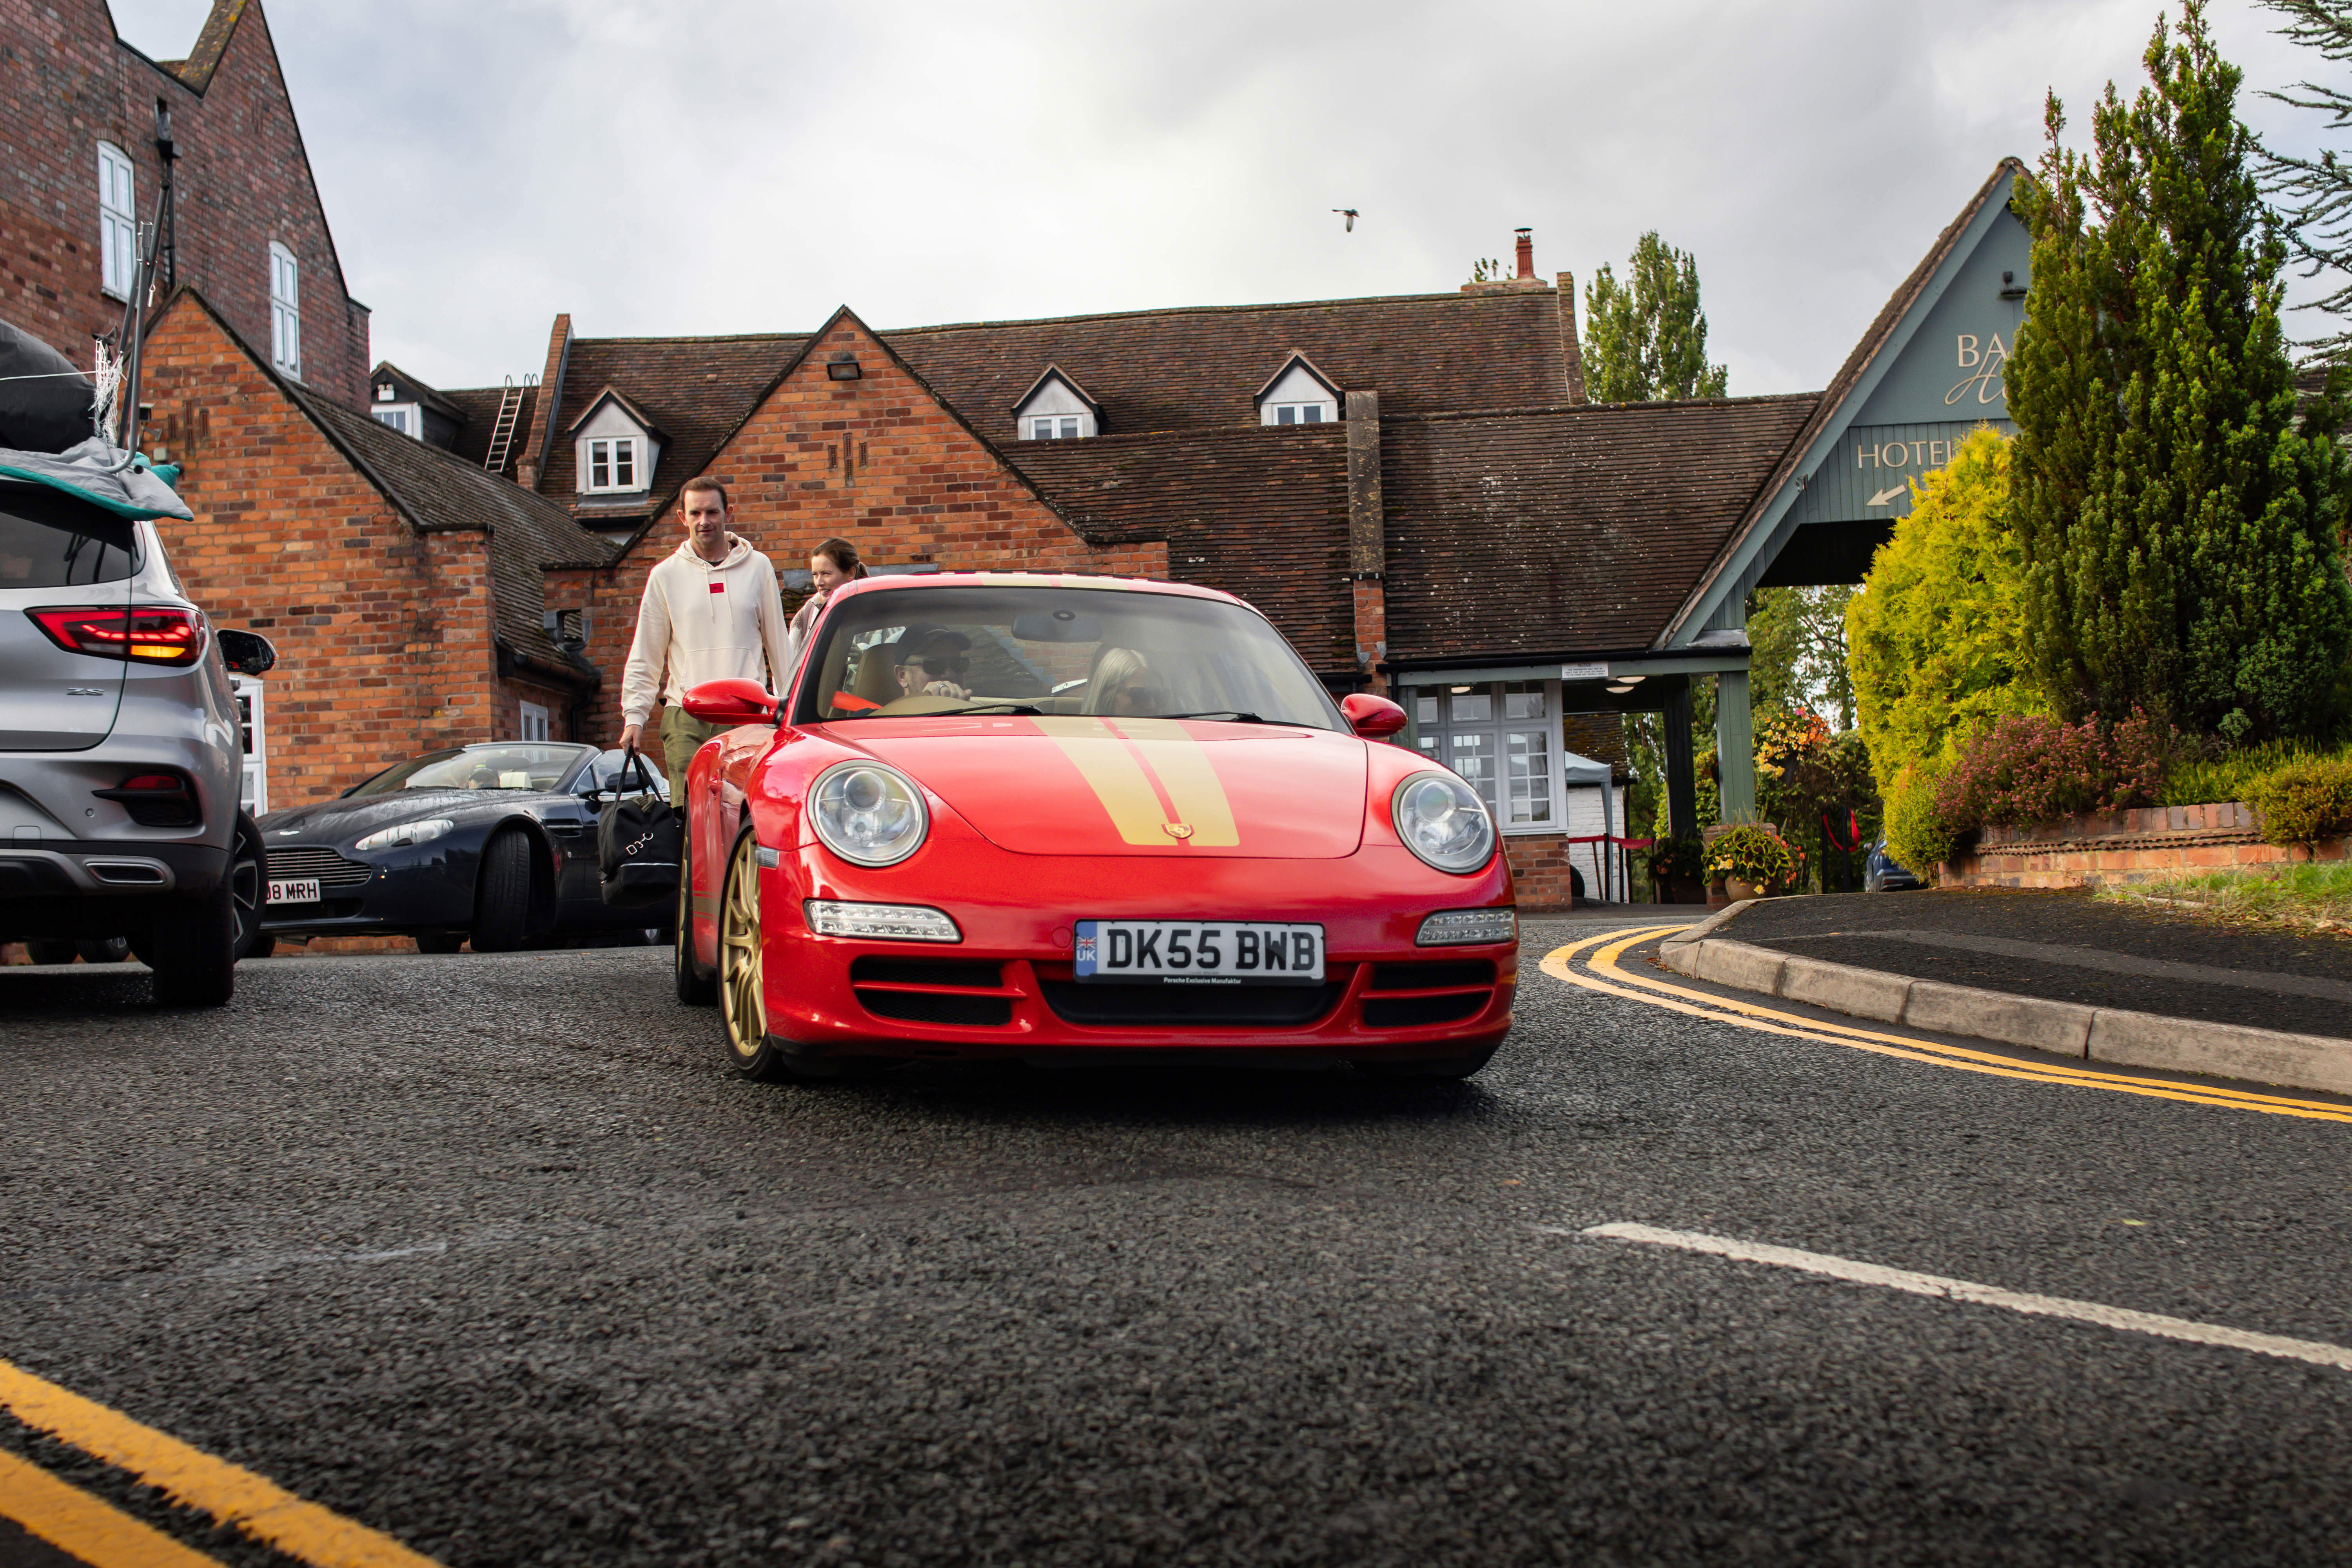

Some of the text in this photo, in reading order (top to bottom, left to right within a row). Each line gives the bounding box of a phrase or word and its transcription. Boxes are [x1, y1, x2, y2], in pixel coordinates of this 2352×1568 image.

[67, 688, 105, 696] ZS
[286, 882, 317, 900] MRH
[1077, 950, 1096, 961] UK
[1107, 929, 1315, 971] DK55 BWB
